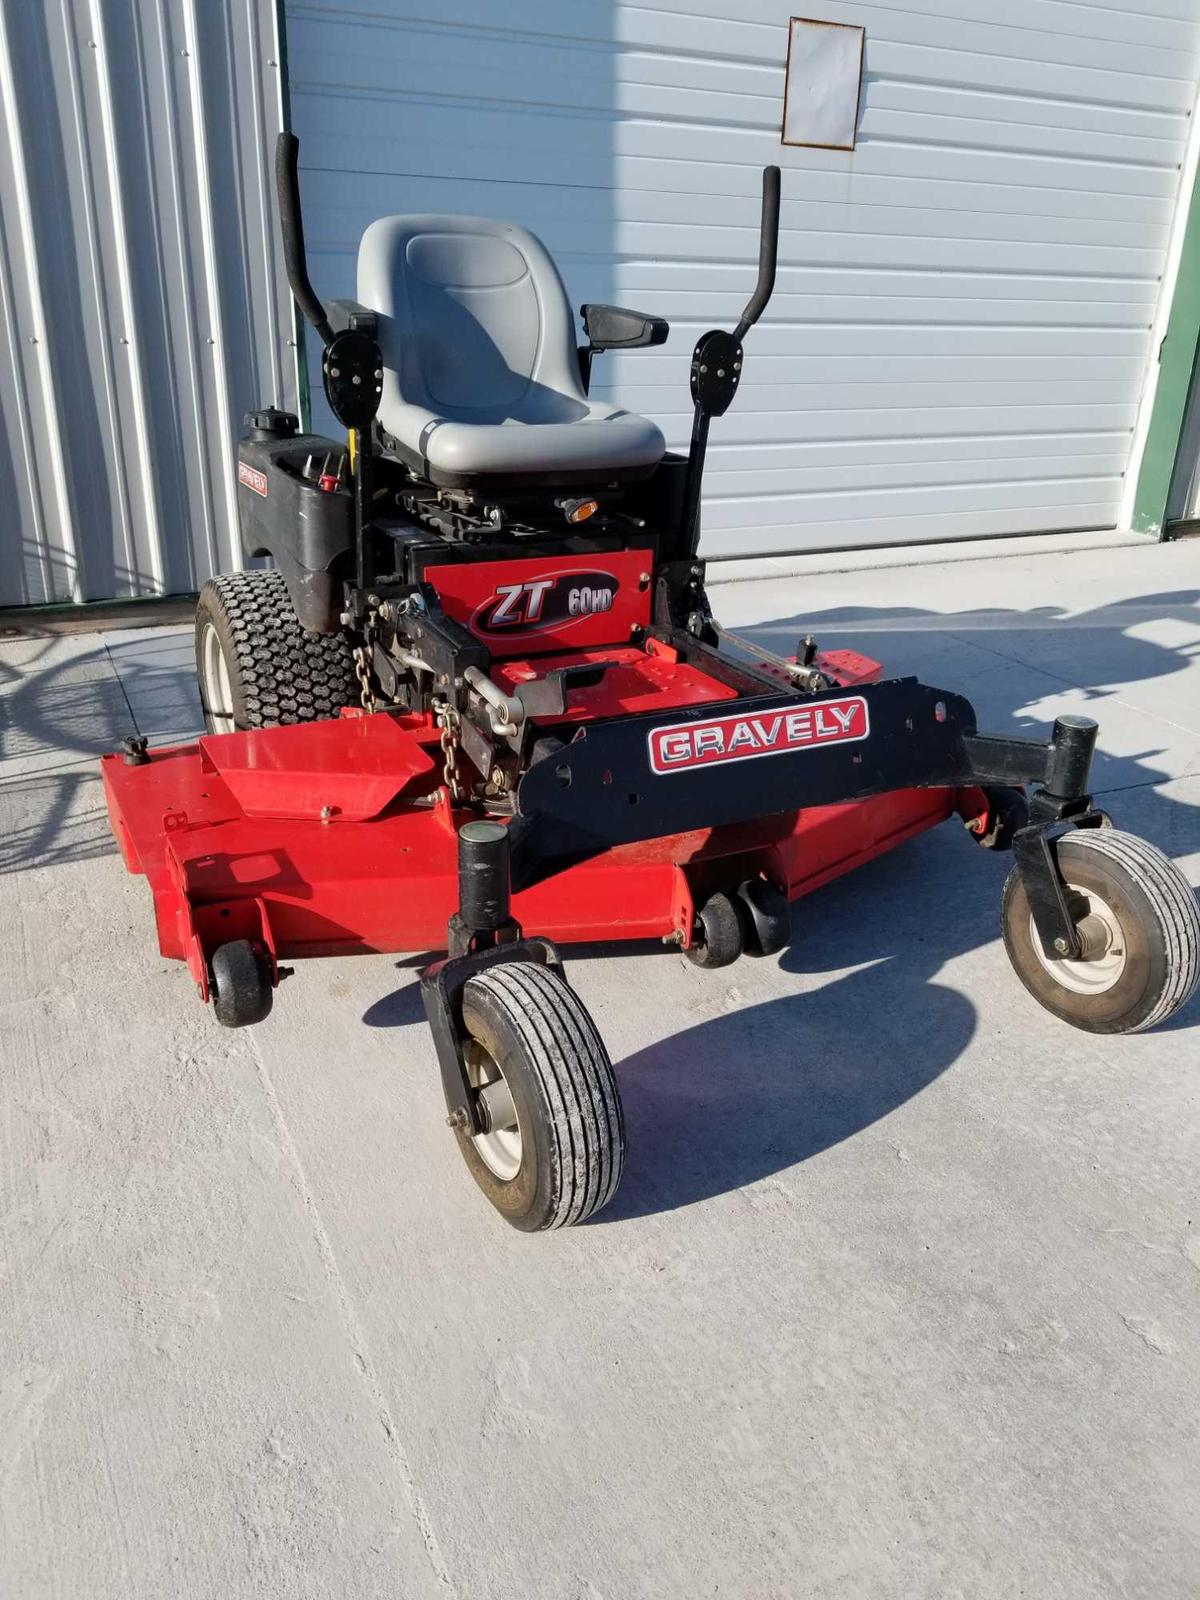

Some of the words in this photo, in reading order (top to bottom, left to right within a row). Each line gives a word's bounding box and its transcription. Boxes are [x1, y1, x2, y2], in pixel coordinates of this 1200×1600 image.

[491, 580, 553, 624] ZT
[568, 587, 612, 615] 60HD
[659, 703, 861, 763] GRAVELY
